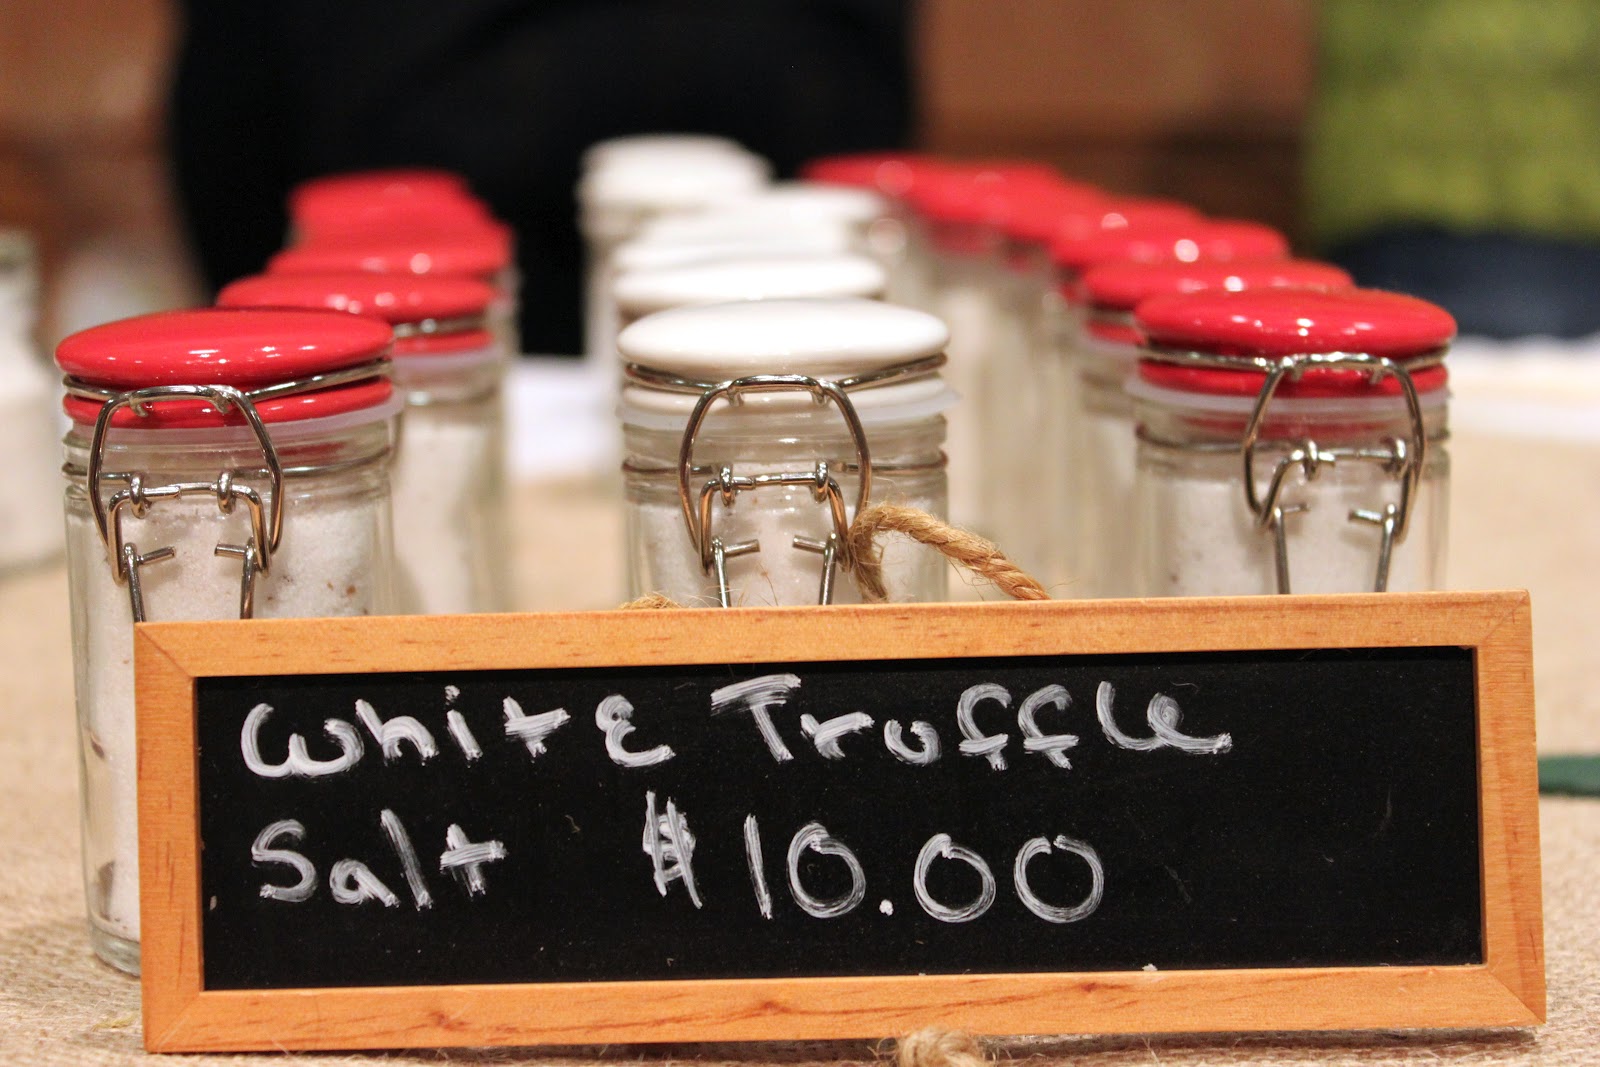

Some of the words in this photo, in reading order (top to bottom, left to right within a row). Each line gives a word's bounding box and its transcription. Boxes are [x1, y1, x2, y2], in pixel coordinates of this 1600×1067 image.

[710, 673, 1233, 771] Truffle
[250, 809, 506, 912] Salt
[642, 790, 1105, 924] $10.00
